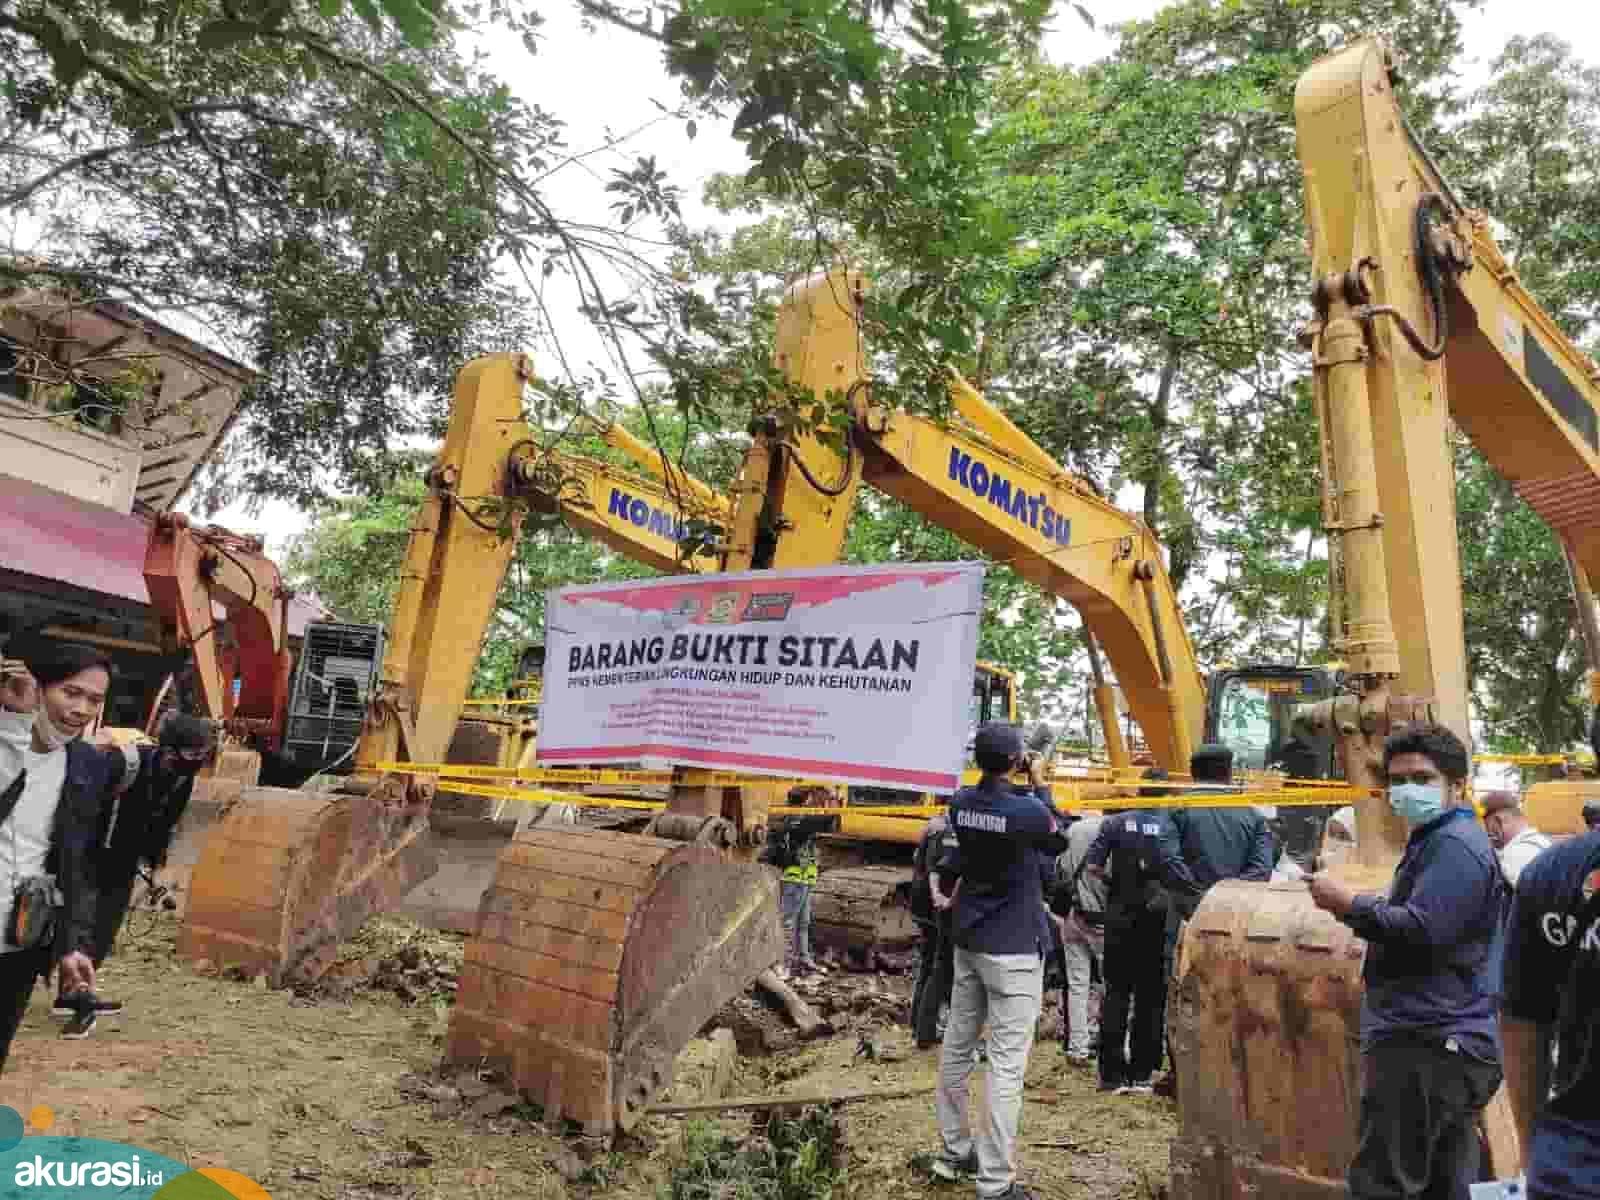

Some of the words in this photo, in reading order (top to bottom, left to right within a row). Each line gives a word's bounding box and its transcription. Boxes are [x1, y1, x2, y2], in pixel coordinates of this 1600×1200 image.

[948, 446, 1071, 545] KOMATSU
[568, 637, 665, 672] BARANG
[669, 633, 769, 665] BUKTI
[778, 634, 920, 673] SITAAN
[740, 671, 782, 686] HIDUP
[784, 672, 815, 688] DAN
[818, 674, 913, 693] KEHUTANAN
